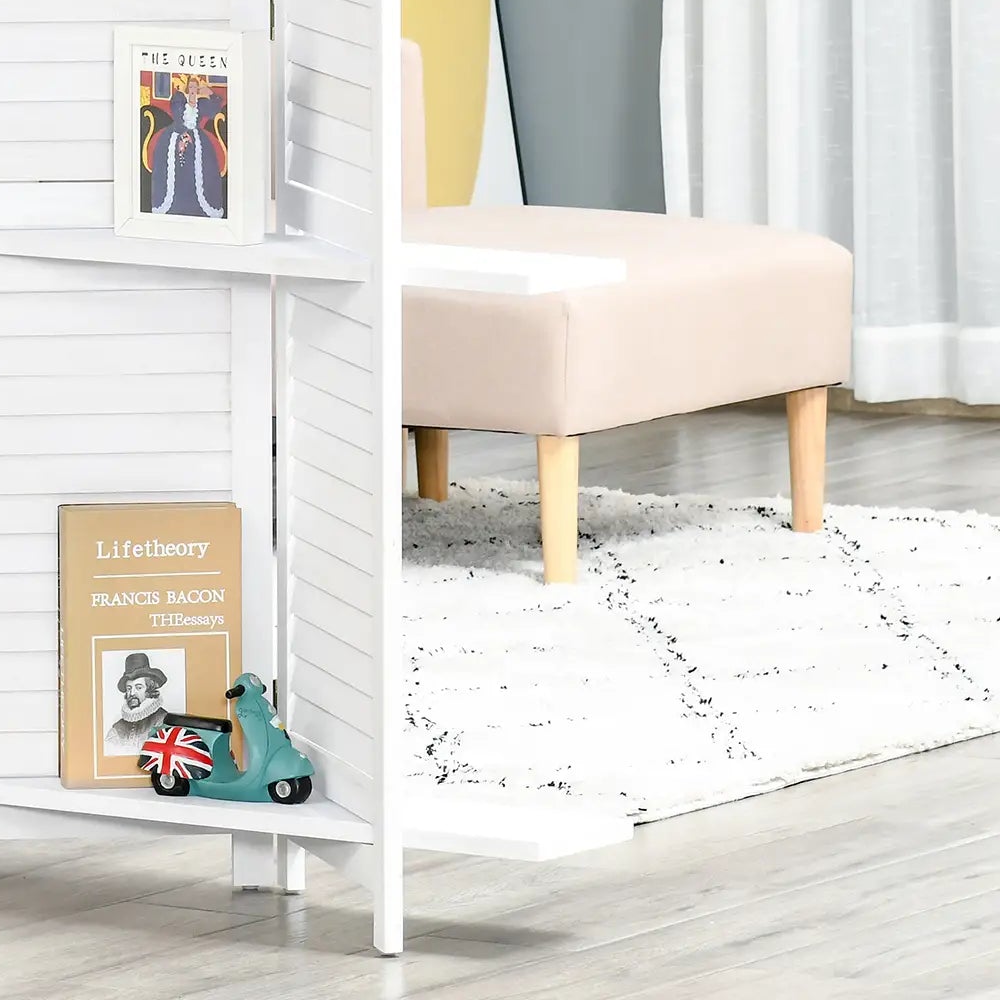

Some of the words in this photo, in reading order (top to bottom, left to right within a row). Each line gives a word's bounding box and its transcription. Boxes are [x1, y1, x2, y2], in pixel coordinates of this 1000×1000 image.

[177, 54, 228, 68] QUEEN
[96, 539, 210, 559] Lifetheory
[91, 592, 160, 607] FRANCIS
[167, 589, 225, 604] BACON
